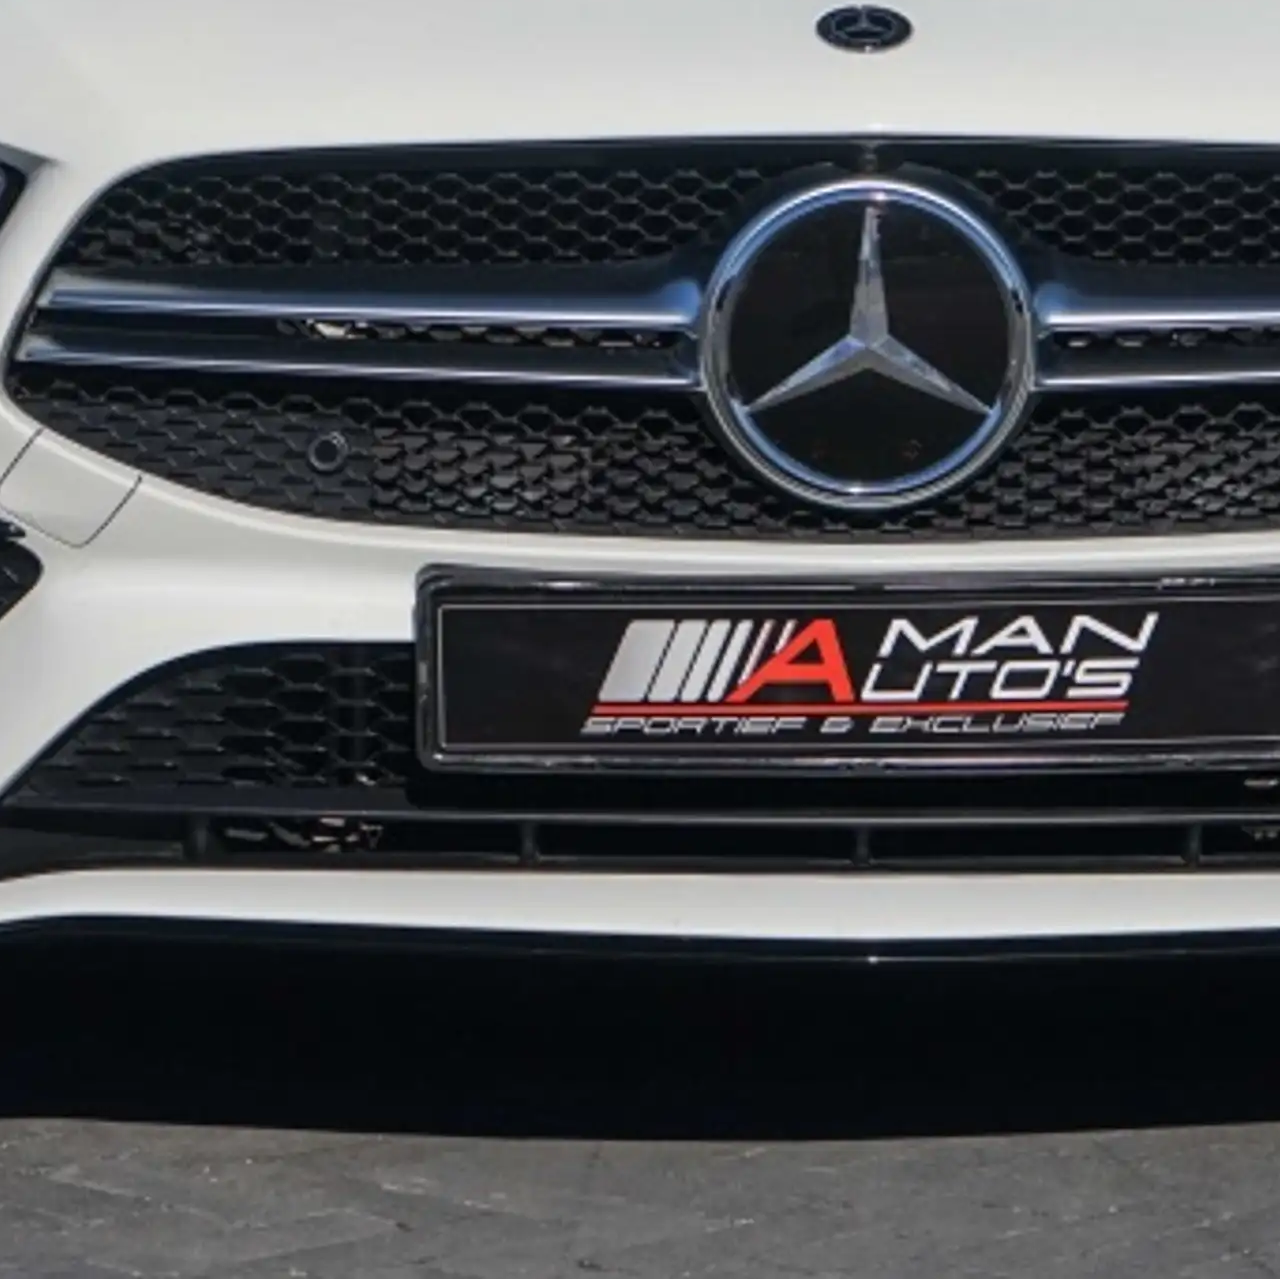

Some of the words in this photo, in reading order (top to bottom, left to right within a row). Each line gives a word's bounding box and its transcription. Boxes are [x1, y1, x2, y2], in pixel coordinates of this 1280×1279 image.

[877, 612, 1159, 658] MAN
[579, 716, 808, 734] SPORTIEF
[869, 712, 1125, 733] EXCLUSIEF
